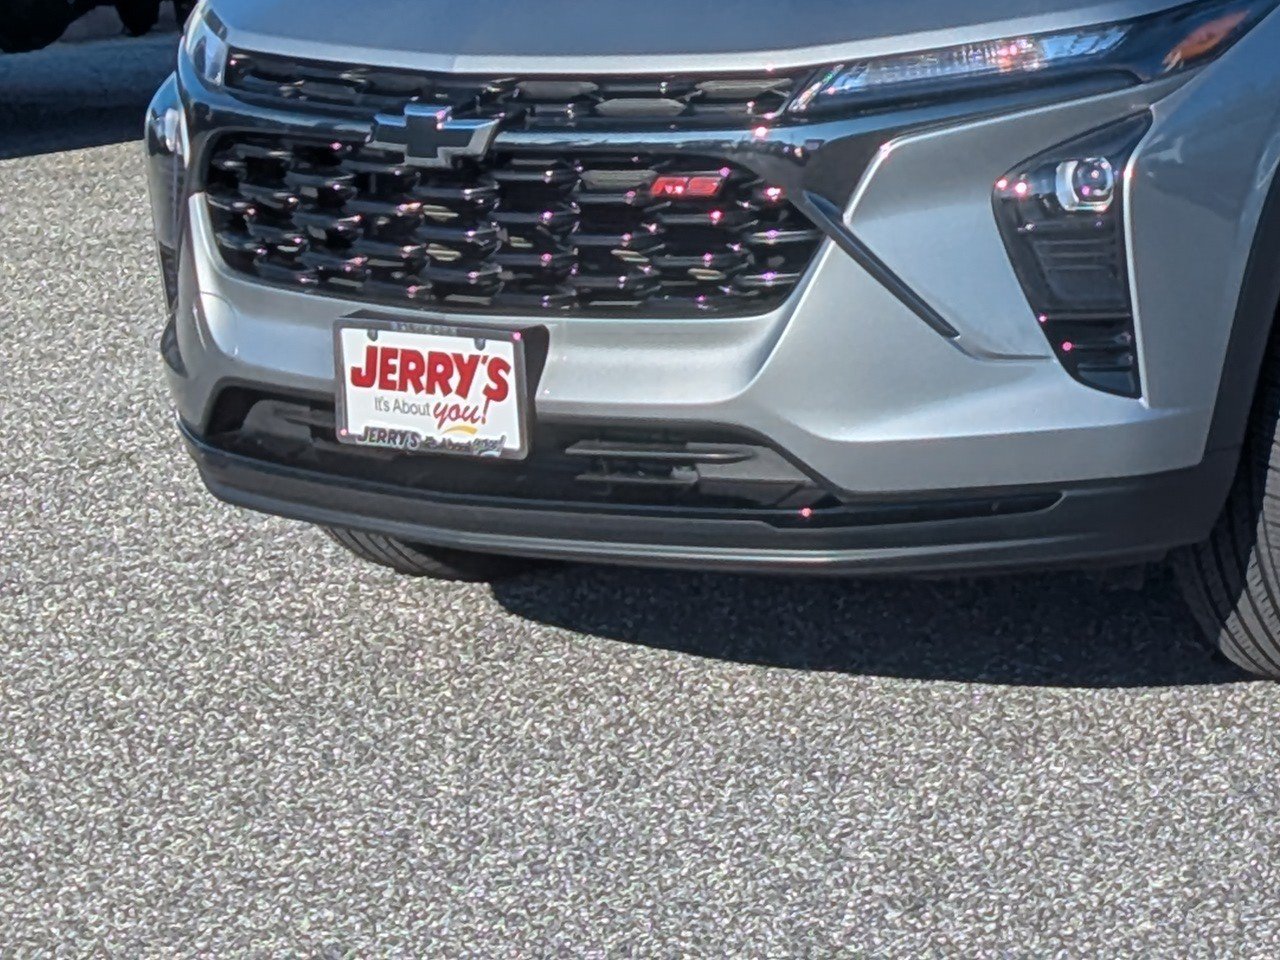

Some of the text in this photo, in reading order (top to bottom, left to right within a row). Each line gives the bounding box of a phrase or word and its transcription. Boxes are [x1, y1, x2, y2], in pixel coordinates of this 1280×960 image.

[351, 345, 512, 402] JERRY'S
[374, 395, 490, 430] It's About you!
[356, 425, 422, 450] JERRY'S
